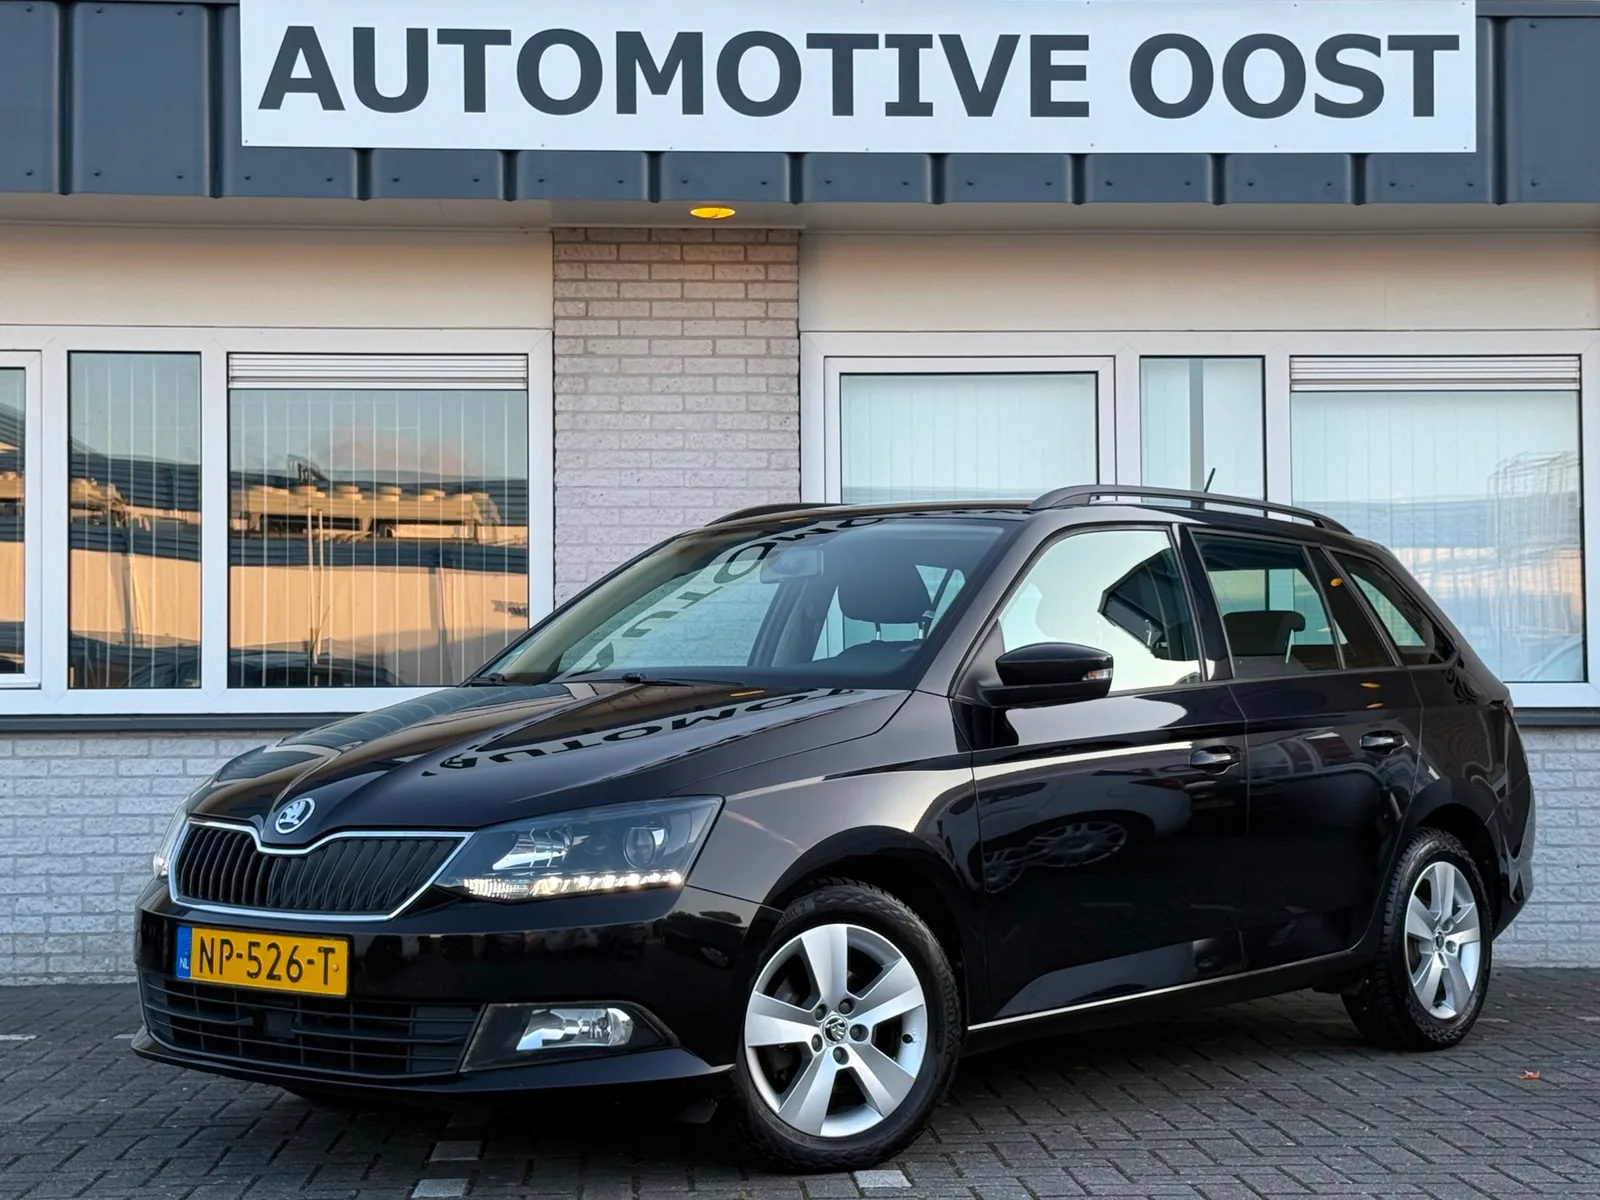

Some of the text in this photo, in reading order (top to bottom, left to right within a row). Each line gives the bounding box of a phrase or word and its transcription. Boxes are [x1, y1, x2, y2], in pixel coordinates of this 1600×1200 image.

[259, 26, 1459, 119] AUTOMOTIVE OOST
[180, 957, 190, 969] NL
[199, 936, 336, 985] NP-526-T
